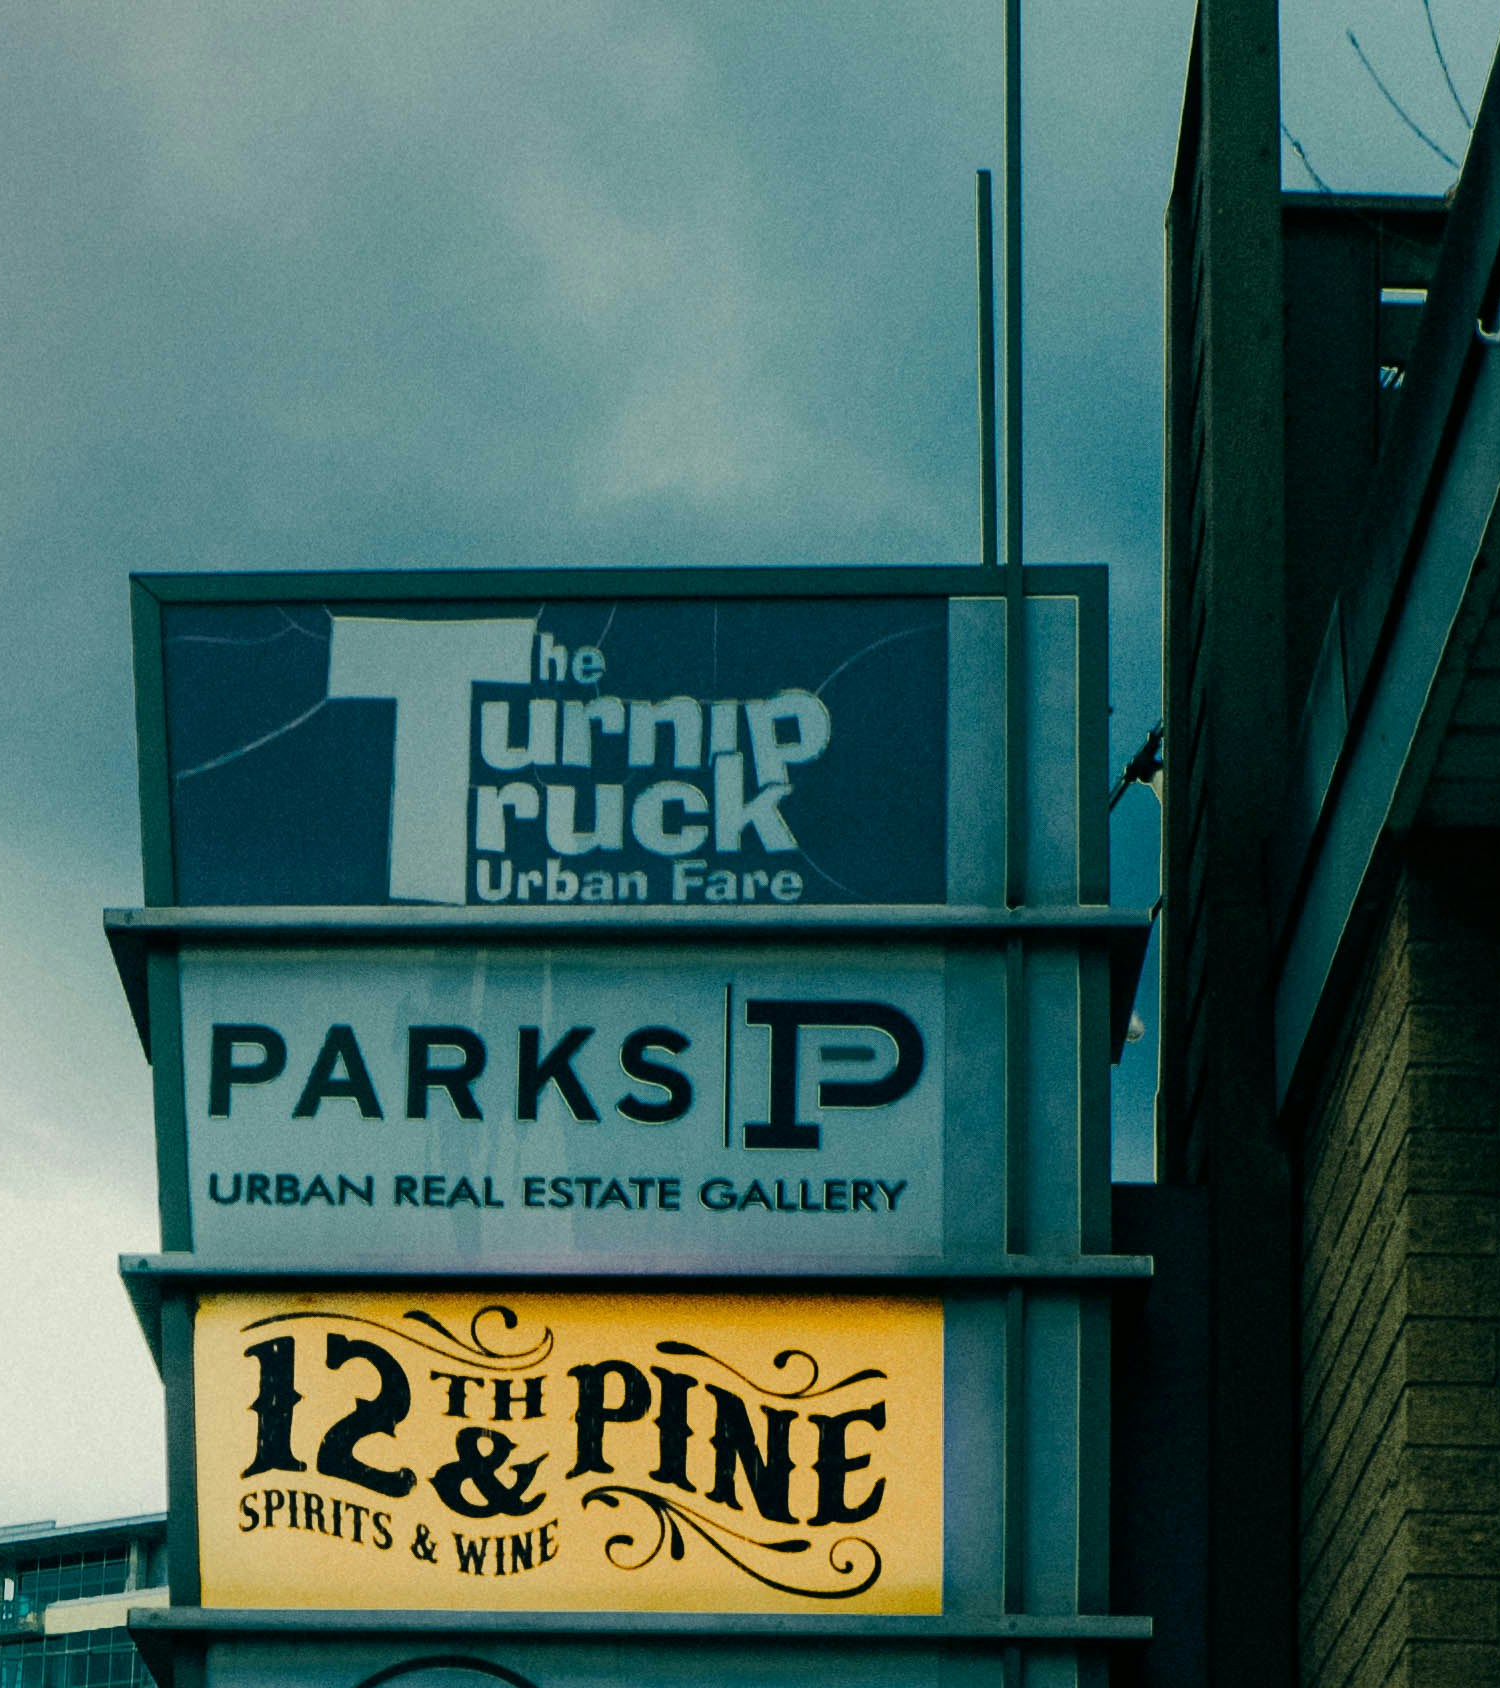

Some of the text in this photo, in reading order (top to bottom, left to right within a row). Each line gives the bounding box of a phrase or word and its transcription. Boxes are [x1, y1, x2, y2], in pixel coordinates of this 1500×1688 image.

[475, 857, 805, 903] Urban Fare
[207, 1021, 695, 1126] PARKS
[207, 1173, 908, 1214] URBAN REAL ESTATE GALLERY
[566, 1358, 887, 1528] PINE
[239, 1488, 560, 1577] SPIRITS & WINE
